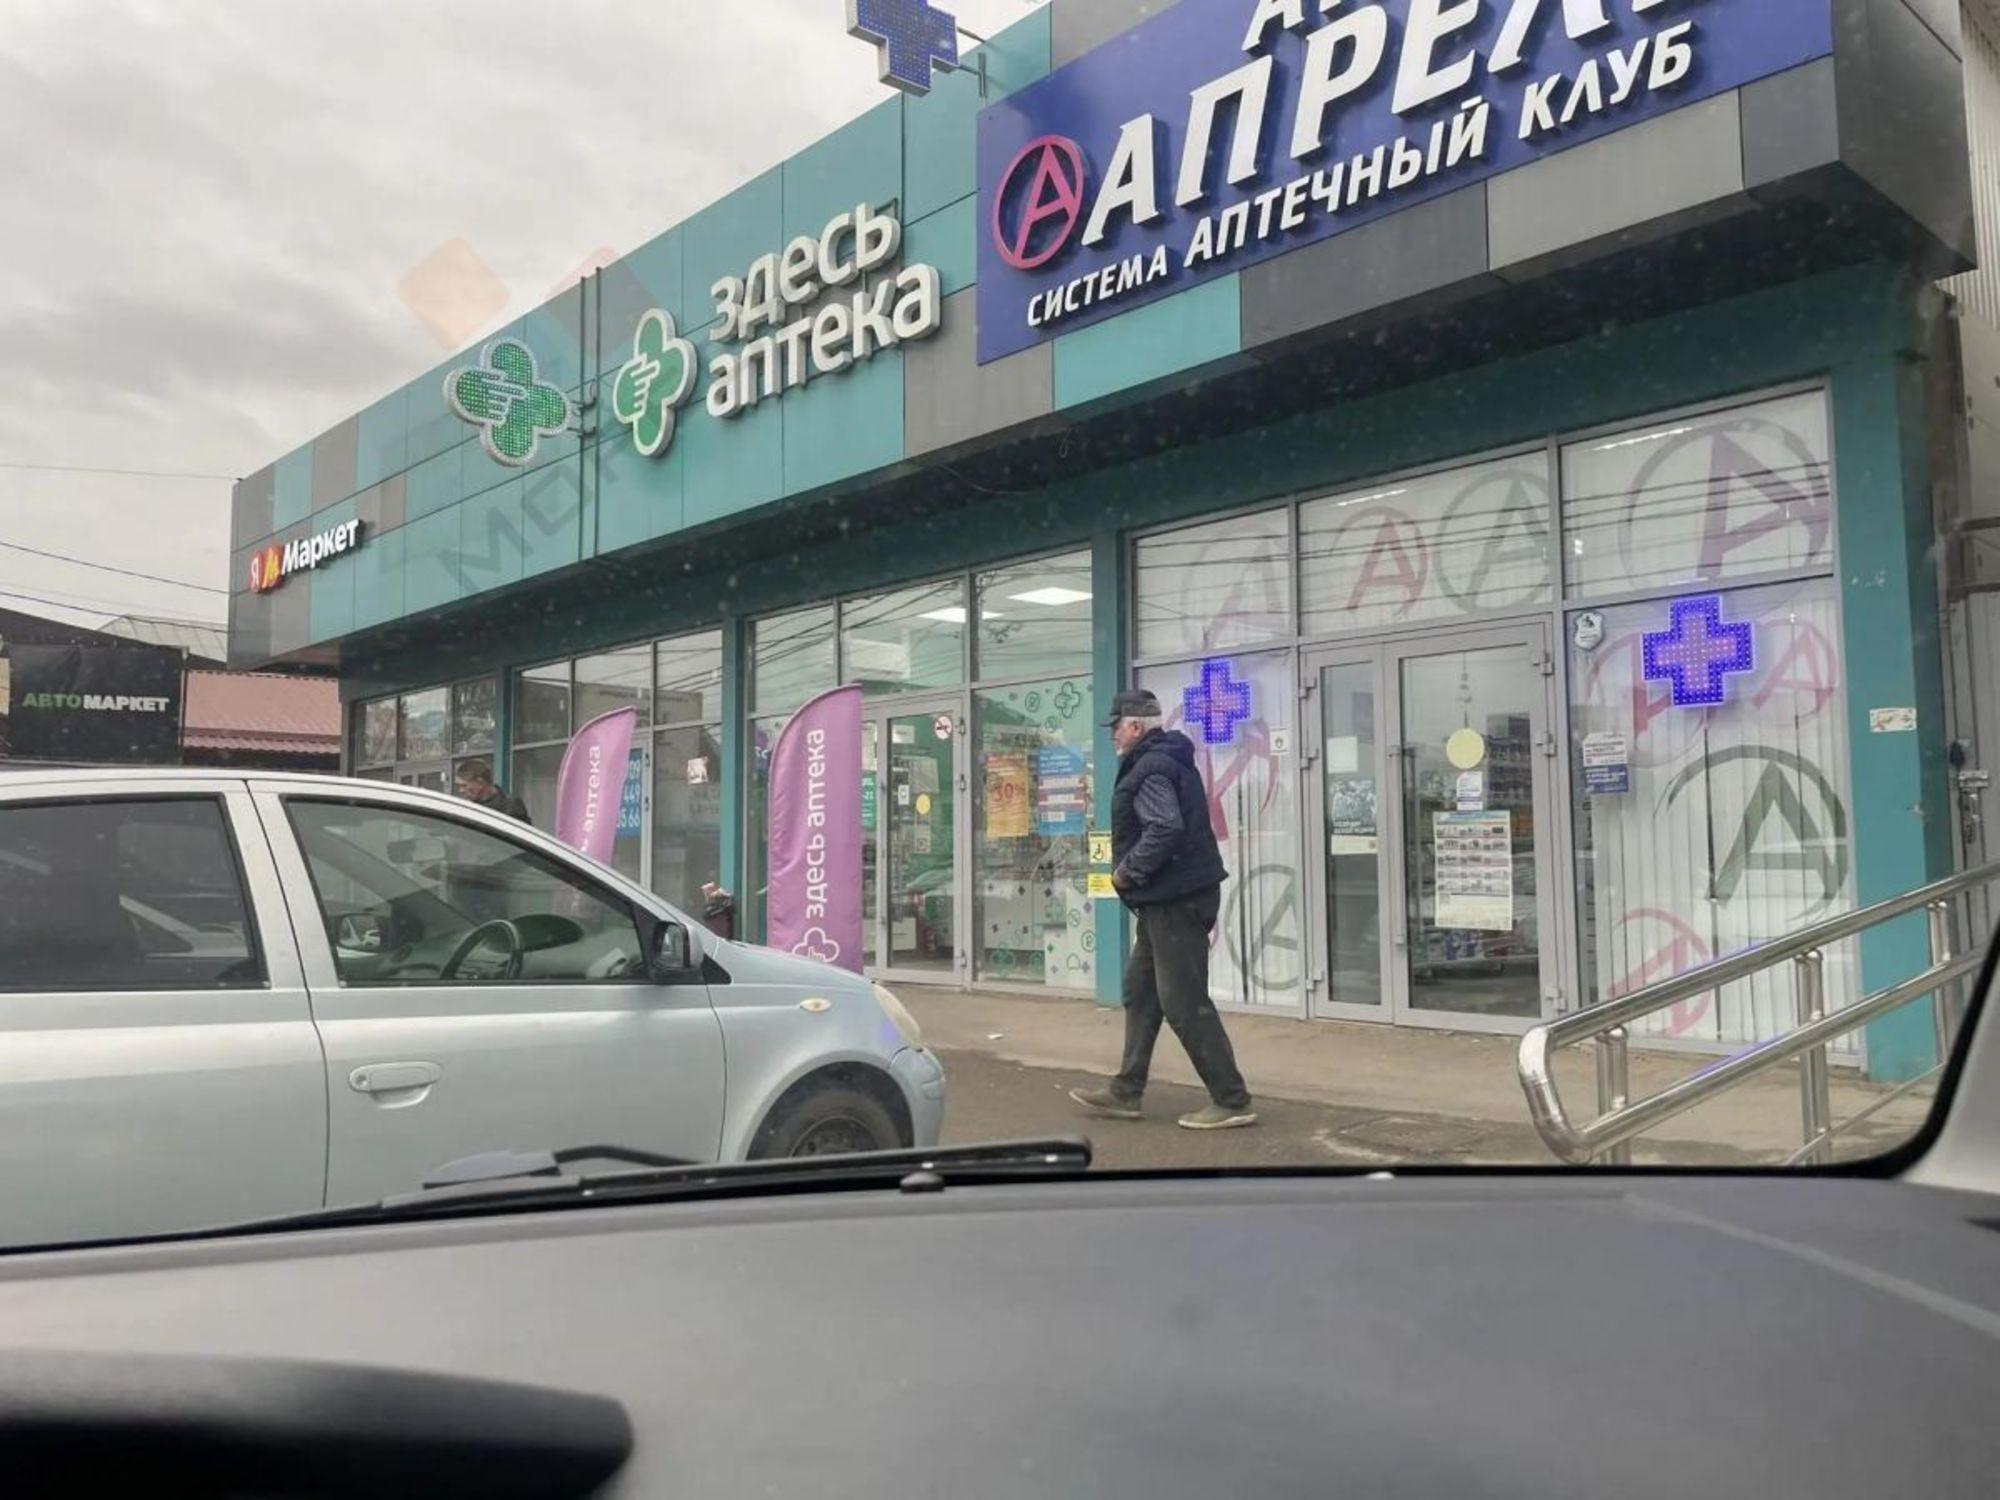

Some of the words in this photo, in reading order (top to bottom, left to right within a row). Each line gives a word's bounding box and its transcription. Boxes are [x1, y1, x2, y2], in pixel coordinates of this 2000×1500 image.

[1027, 245, 1168, 326] СИСТЕМА
[1184, 95, 1490, 267] АПТЕЧНЫЙ
[1519, 21, 1693, 139] КЛУБ
[1081, 0, 1675, 245] АПРЕ
[709, 202, 901, 342] здесь
[706, 263, 940, 418] аптека
[281, 519, 360, 576] Маркет
[582, 745, 601, 833] аптека
[806, 729, 826, 827] аптека
[806, 833, 828, 919] здесь
